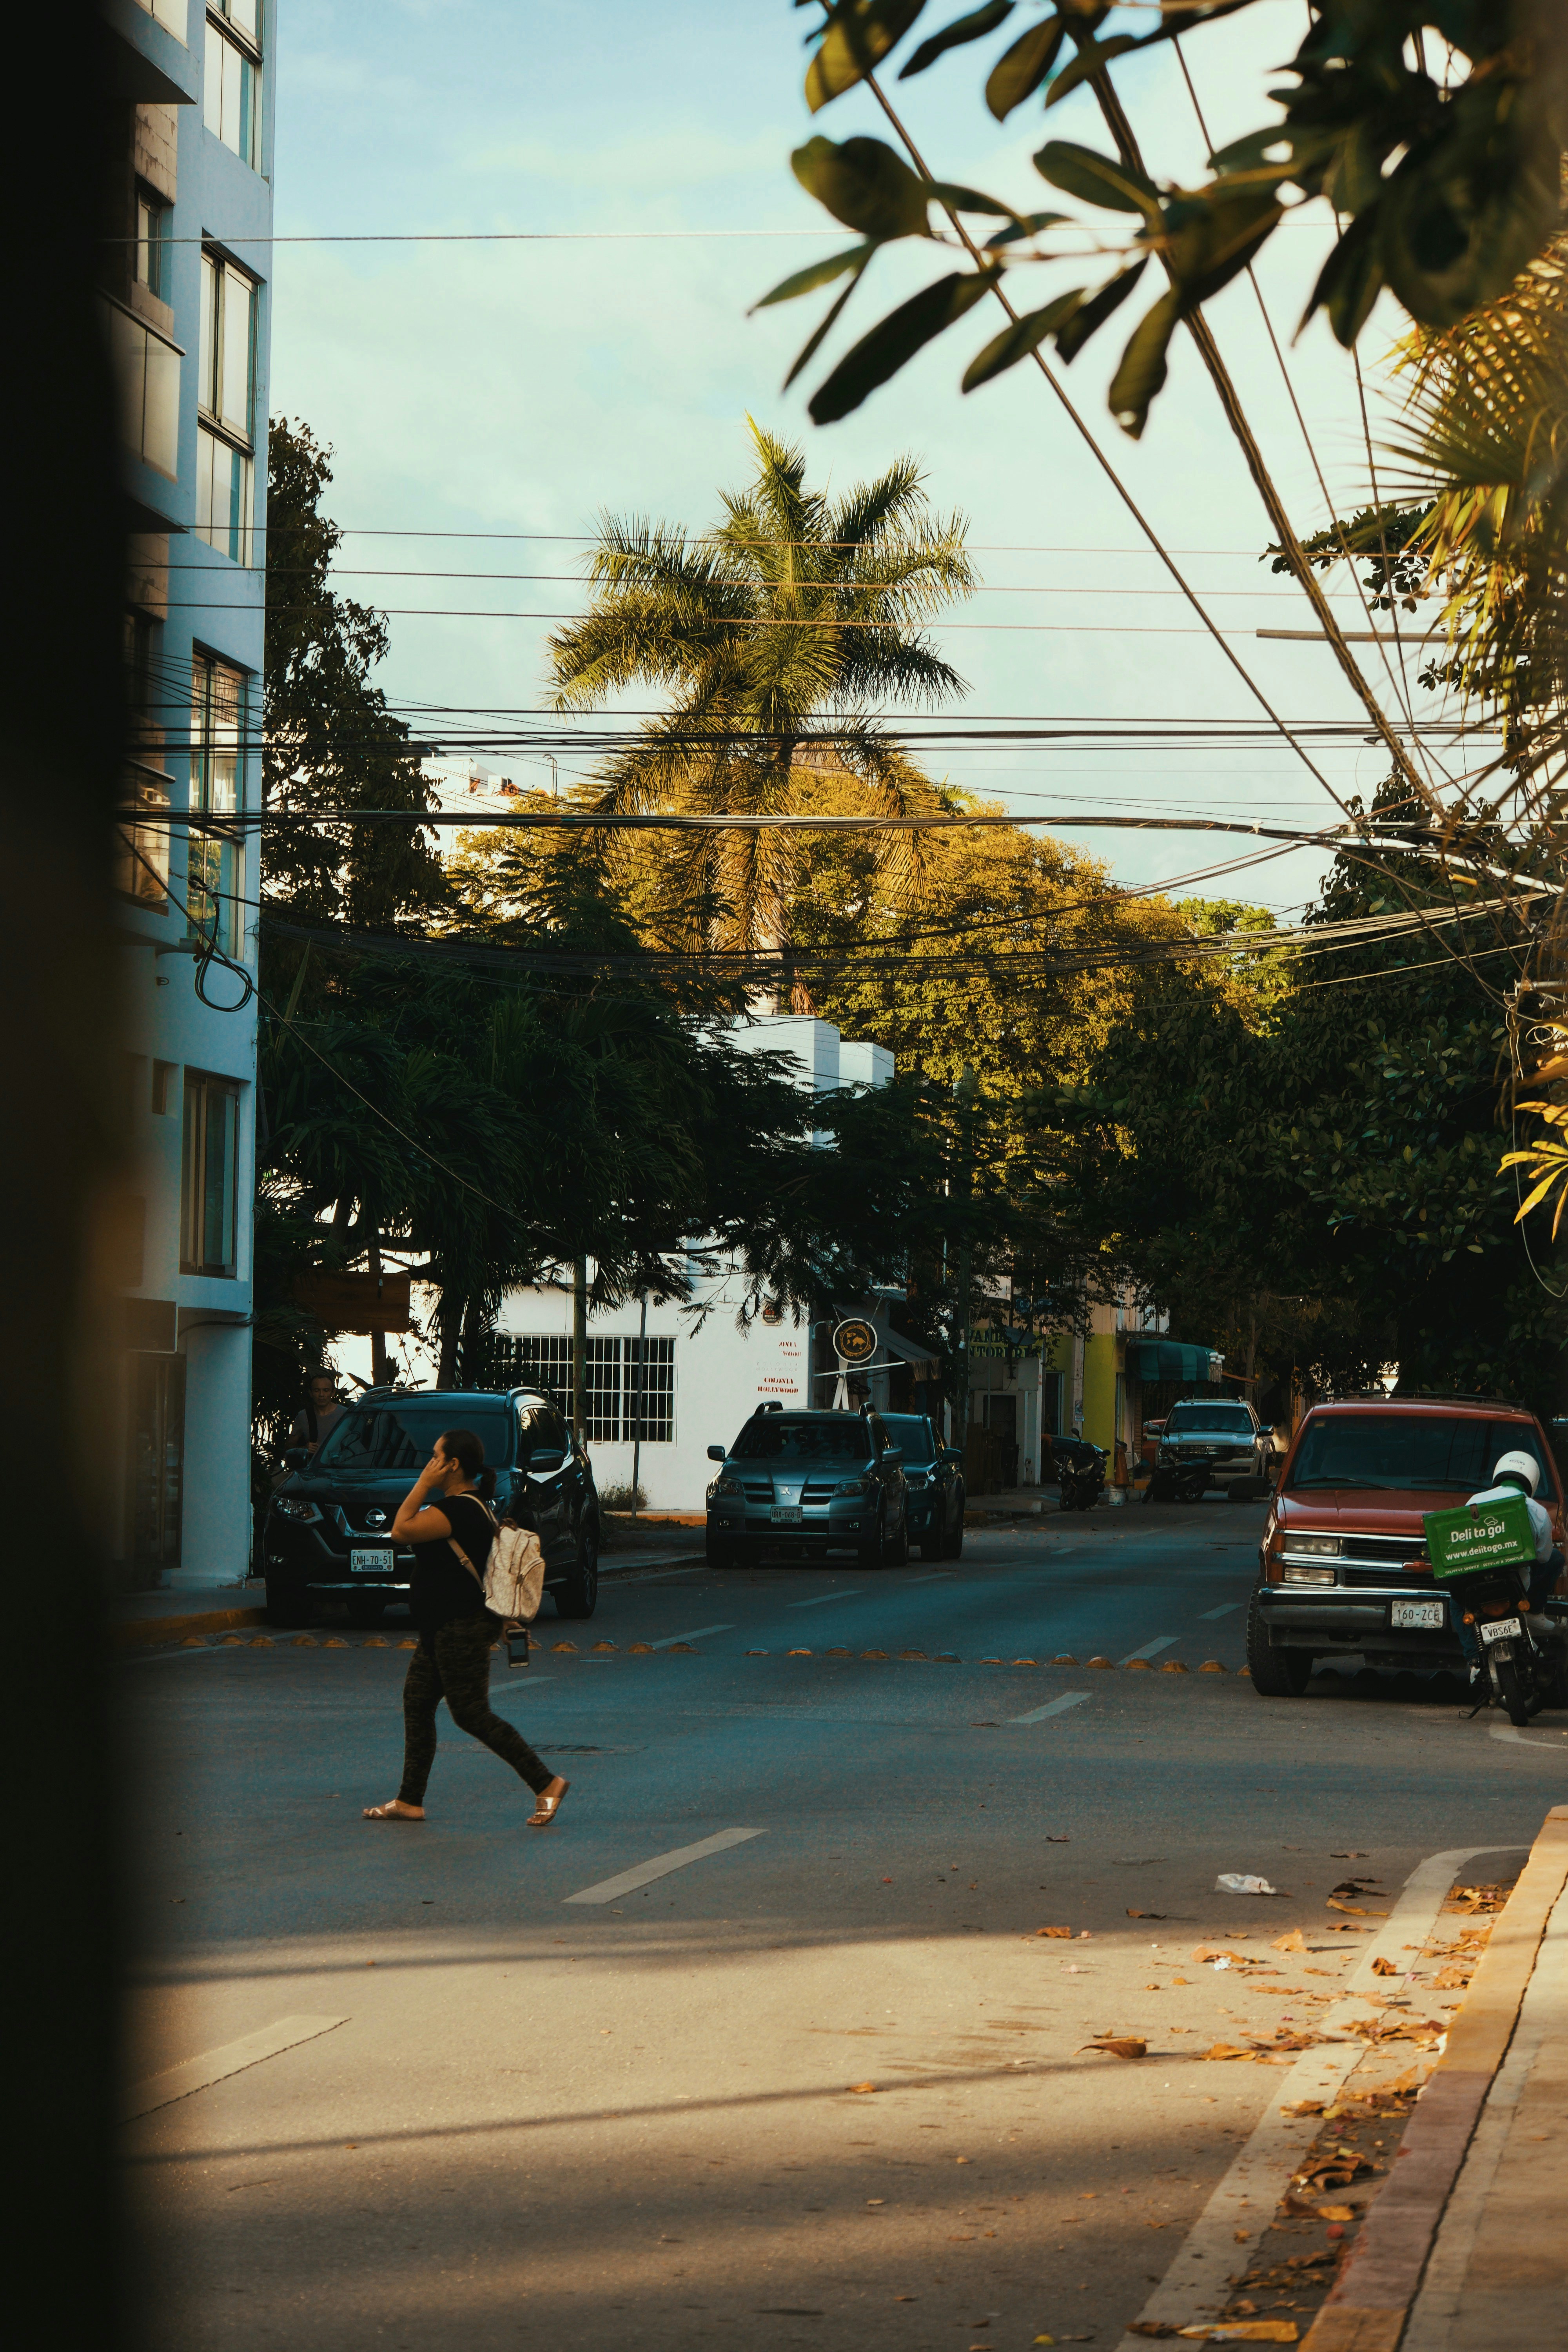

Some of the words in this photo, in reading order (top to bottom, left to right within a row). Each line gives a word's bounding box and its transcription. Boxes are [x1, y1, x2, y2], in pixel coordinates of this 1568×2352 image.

[1451, 1528, 1472, 1543] Deli
[1474, 1527, 1486, 1538] to
[1488, 1522, 1505, 1539] go!
[352, 1555, 391, 1565] ENH-70-51
[1397, 1610, 1439, 1621] 160-ZCE
[1488, 1625, 1514, 1637] VBS6E
